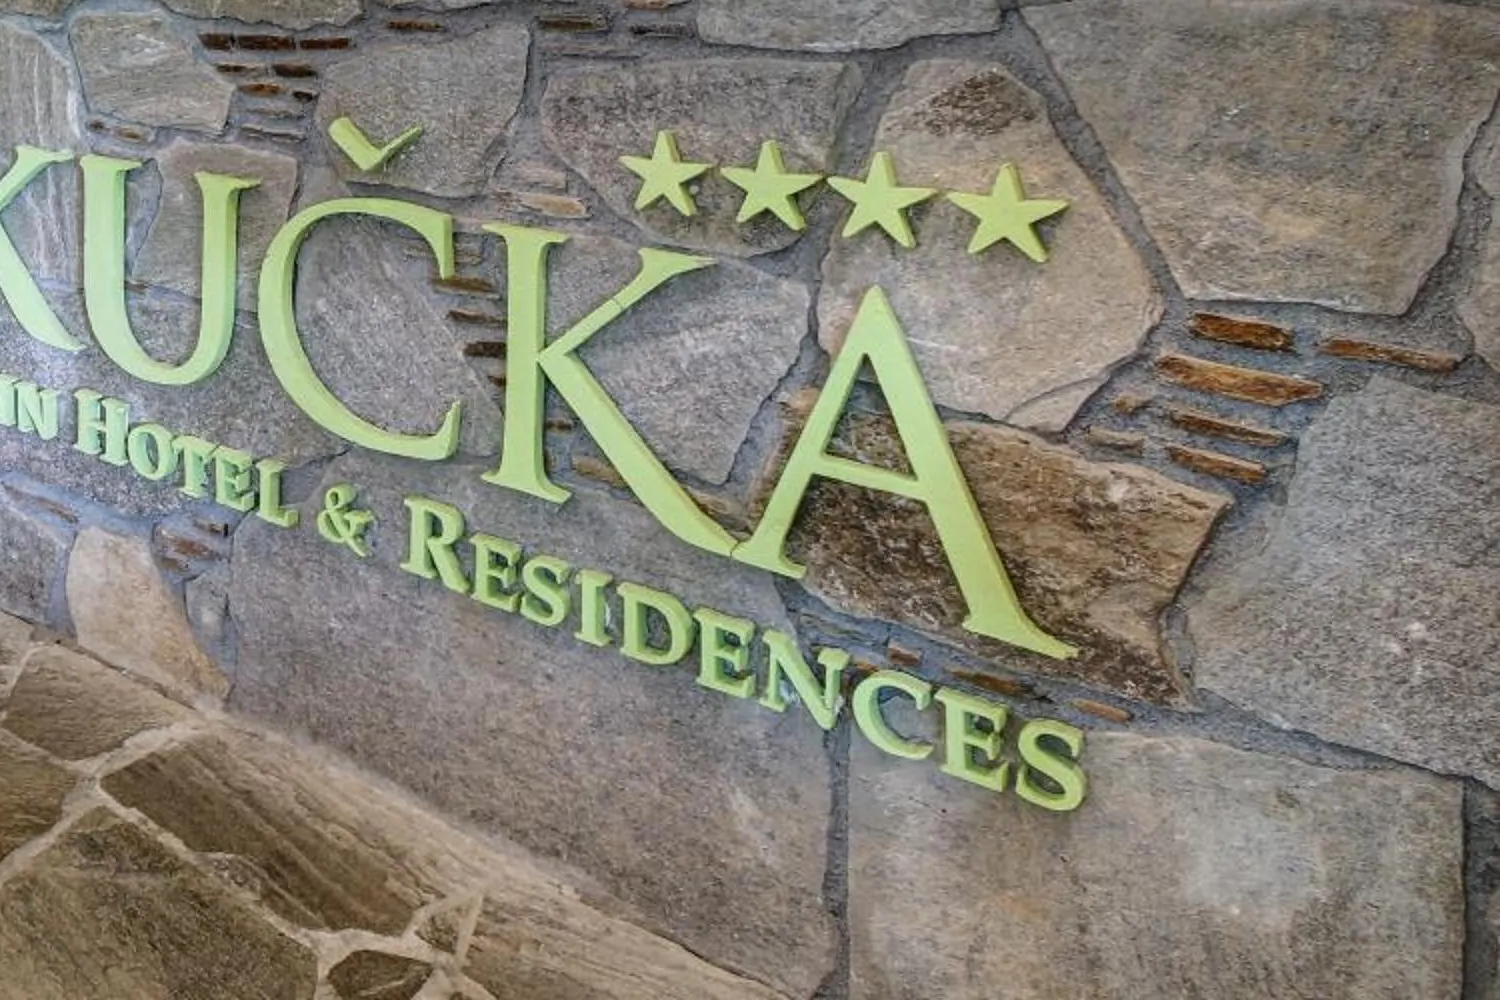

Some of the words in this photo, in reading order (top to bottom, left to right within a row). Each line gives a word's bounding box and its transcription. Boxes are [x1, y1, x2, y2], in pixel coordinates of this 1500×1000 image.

[72, 387, 300, 529] HOTEL
[316, 482, 375, 558] &
[399, 493, 1090, 813] RESIDENCES
